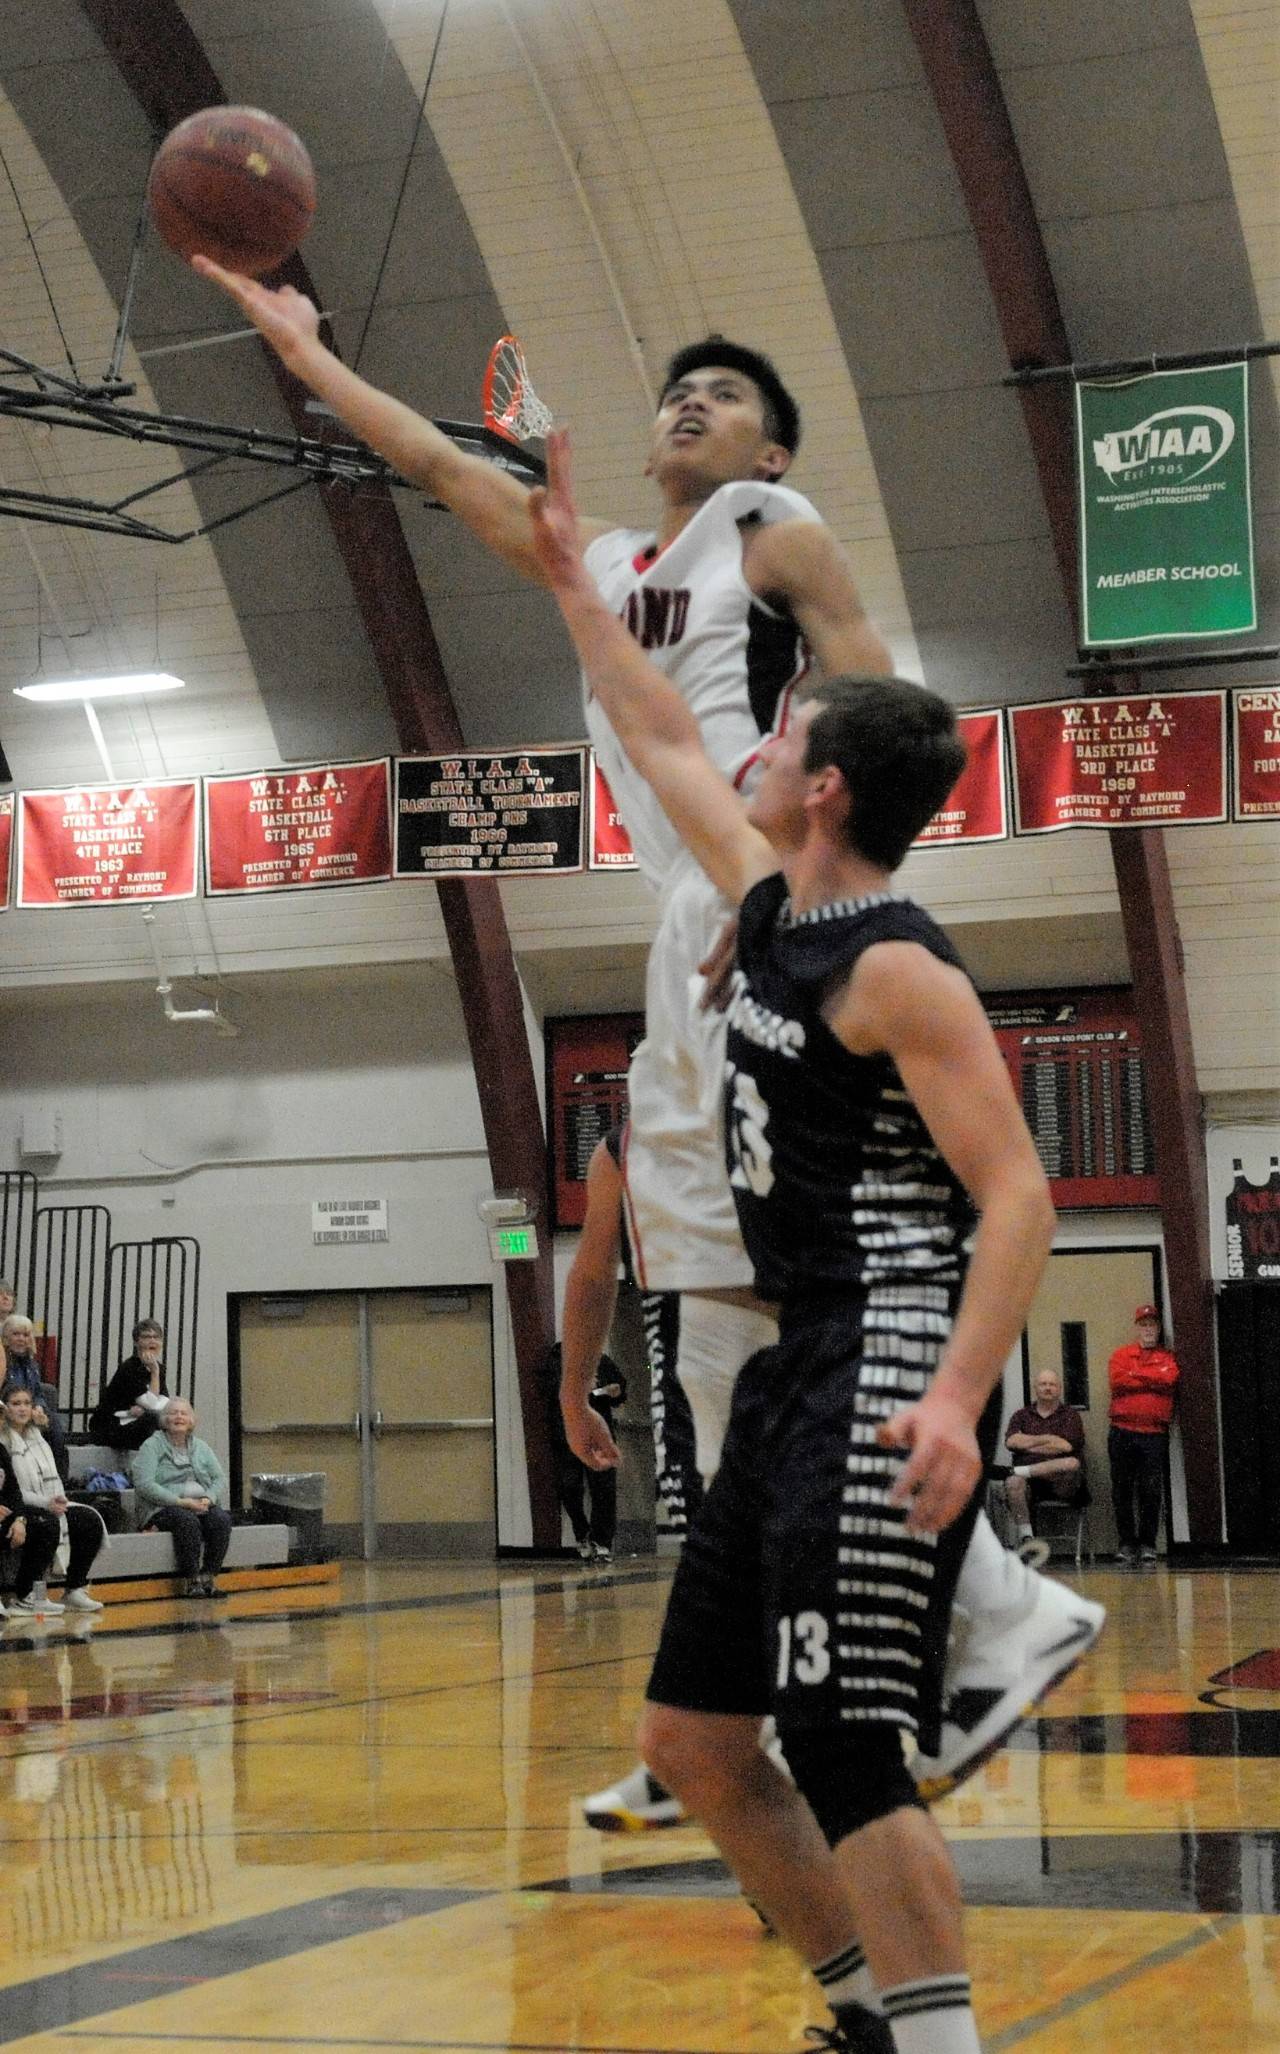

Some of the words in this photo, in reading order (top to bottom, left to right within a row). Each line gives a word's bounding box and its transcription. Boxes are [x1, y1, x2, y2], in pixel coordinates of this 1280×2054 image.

[1117, 425, 1212, 463] WIAA
[1151, 463, 1183, 475] 1905
[1096, 488, 1149, 503] WASHINGTON
[1151, 482, 1226, 495] INTERSCHOLASTIC
[1114, 497, 1153, 511] ACTIVITIES
[1155, 493, 1209, 504] ASSOCIATION
[1097, 567, 1167, 588] MEMBER
[1171, 563, 1242, 580] SCHOOL
[1238, 693, 1280, 711] CEN
[1062, 727, 1100, 743] STATE
[1110, 725, 1150, 740] CLASS
[1156, 722, 1176, 737] "A"
[1076, 742, 1158, 758] BASKETBALL
[1080, 761, 1106, 774] 3RD
[1116, 759, 1155, 773] PLACE
[430, 780, 473, 796] STATE
[480, 778, 523, 793] CLASS
[527, 777, 554, 791] "A"
[249, 798, 283, 813] STATE
[291, 794, 326, 809] CLASS
[330, 790, 348, 804] "A"
[400, 796, 484, 813] BASKETBALL
[492, 791, 580, 809] TOURNAMENT
[1056, 795, 1109, 807] PRESENTED
[1119, 794, 1131, 804] BY
[1140, 791, 1185, 802] RAYMOND
[1058, 808, 1101, 819] CHAMBER
[1110, 808, 1122, 817] OF
[1131, 804, 1181, 816] COMMERCE
[1243, 802, 1280, 813] PRESEN
[62, 813, 96, 828] STATE
[103, 811, 136, 826] CLASS
[142, 809, 158, 823] "A"
[261, 809, 334, 827] BASKETBALL
[73, 827, 144, 843] BASKETBALL
[264, 829, 289, 842] 6TH
[297, 826, 331, 840] PLACE
[471, 828, 508, 843] 1966
[76, 845, 100, 858] 4TH
[108, 842, 142, 856] PLACE
[284, 843, 314, 856] 1965
[95, 859, 123, 872] 1963
[242, 860, 291, 873] PRESENTED
[299, 858, 310, 867] BY
[317, 853, 358, 864] RAYMOND
[598, 853, 634, 863] PRESEN
[55, 875, 102, 887] PRESENTED
[109, 874, 119, 884] BY
[127, 871, 167, 881] RAYMOND
[246, 872, 285, 884] CHAMBER
[292, 871, 302, 880] OF
[309, 867, 355, 879] COMMERCE
[58, 887, 95, 898] CHAMBER
[102, 886, 112, 895] OF
[119, 883, 163, 894] COMMERCE
[1227, 1223, 1244, 1278] SENIOR
[777, 1611, 830, 1689] 13
